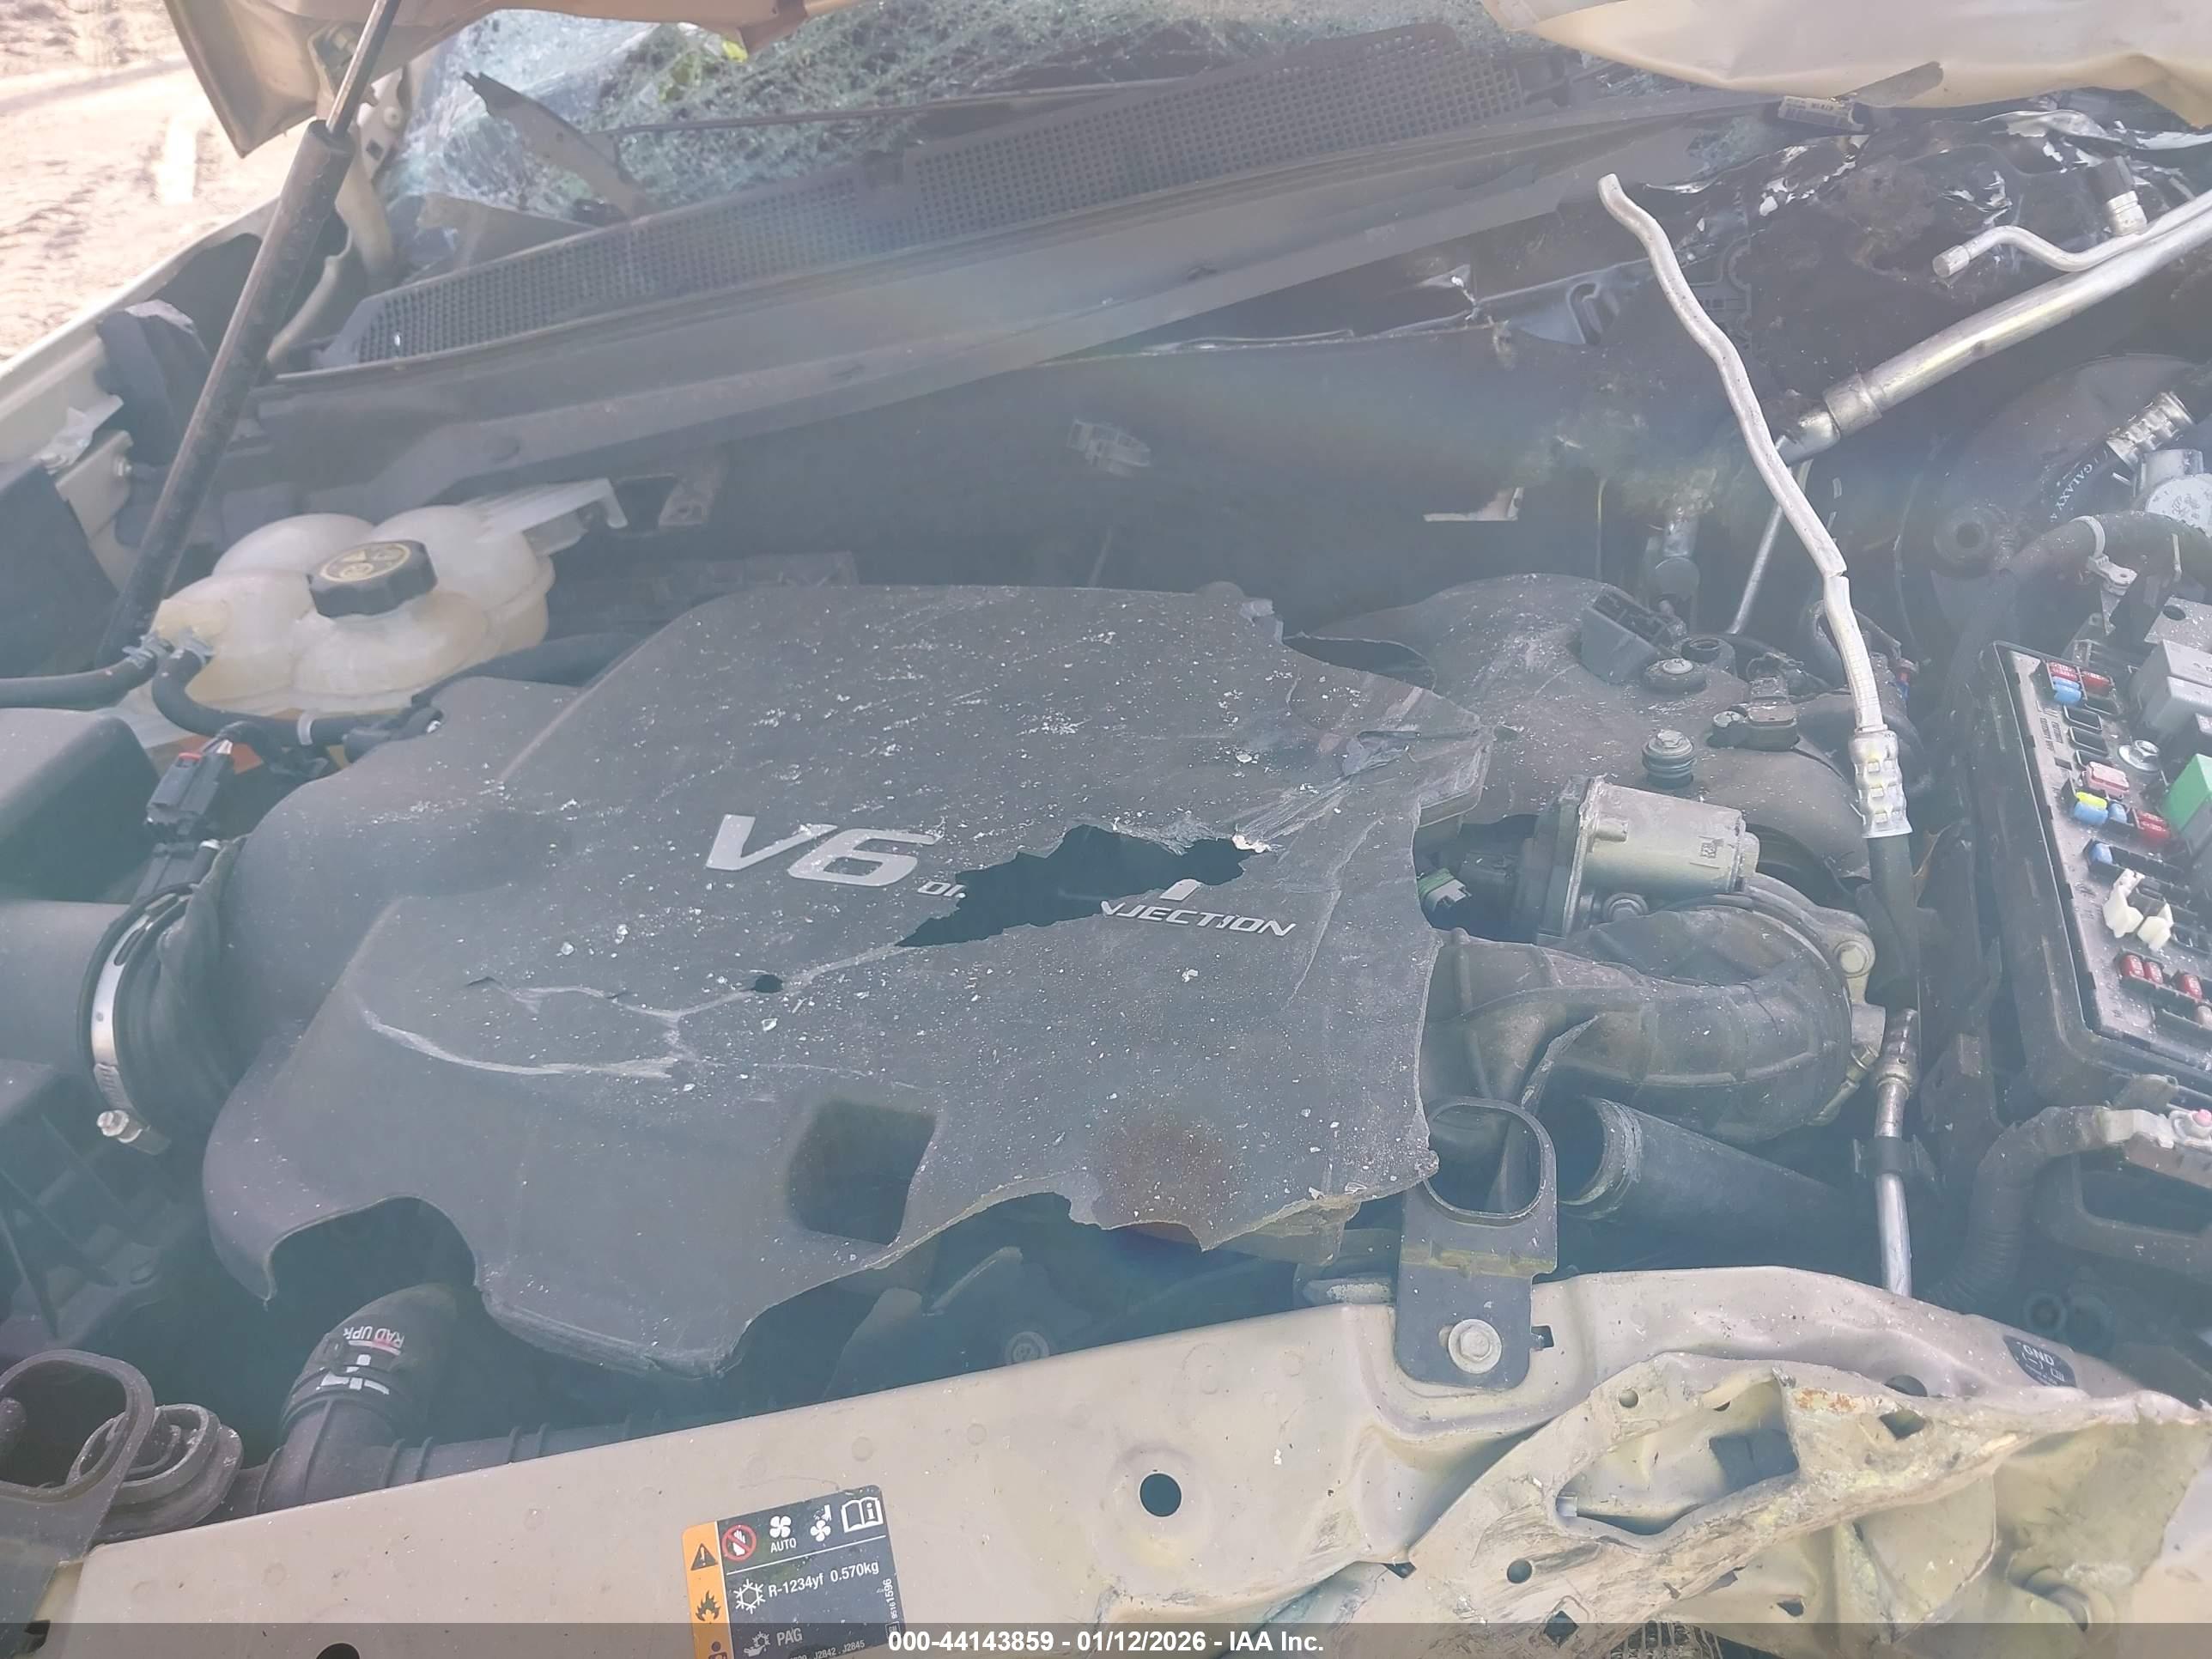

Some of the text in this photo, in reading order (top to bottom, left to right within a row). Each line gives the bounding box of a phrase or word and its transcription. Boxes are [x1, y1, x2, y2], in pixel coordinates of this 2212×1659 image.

[2056, 464, 2094, 510] GALAXY
[704, 813, 942, 887] V6
[1101, 900, 1297, 938] NJECTION
[375, 1328, 405, 1348] RAD
[2023, 1345, 2055, 1366] GND
[770, 1538, 797, 1553] AUTO
[768, 1560, 880, 1598] R-1234yf 0.570kg
[776, 1627, 803, 1647] PAG
